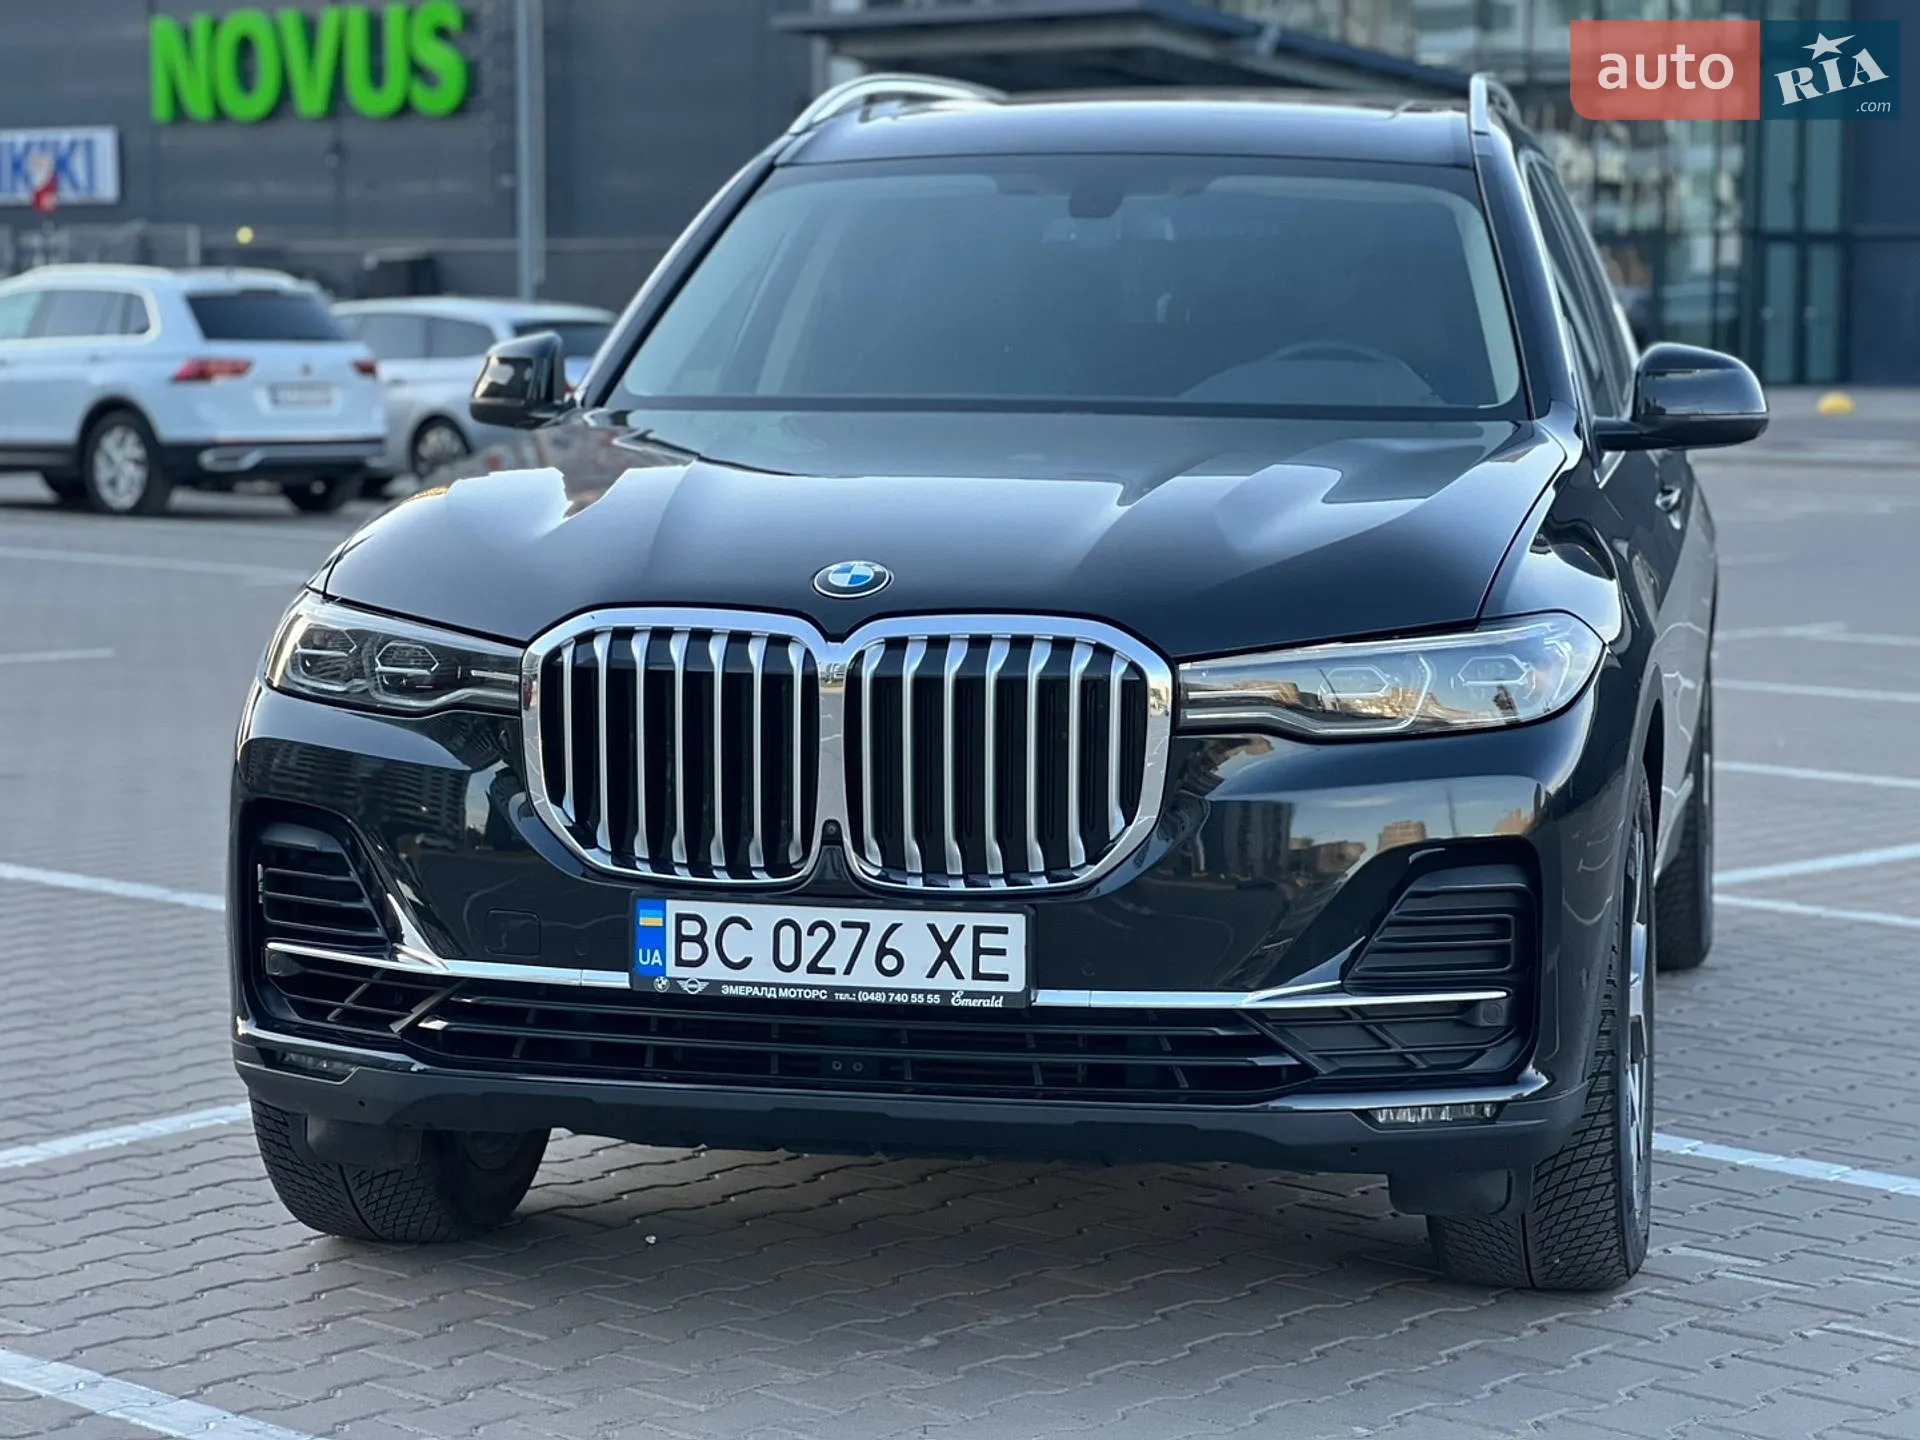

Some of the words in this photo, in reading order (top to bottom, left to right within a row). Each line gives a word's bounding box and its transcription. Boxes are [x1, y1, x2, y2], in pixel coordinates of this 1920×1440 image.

[149, 0, 468, 124] NOVUS
[674, 912, 753, 971] BC
[772, 918, 904, 979] 0276
[925, 923, 1010, 982] XE
[638, 948, 663, 968] UA
[721, 984, 777, 999] ЭМЕРАЛД
[778, 988, 828, 1000] МОТОРС
[857, 990, 887, 1003] (048)
[887, 992, 908, 1004] 740
[910, 994, 926, 1004] 55
[926, 995, 941, 1005] 55
[950, 990, 1004, 1009] Emerald
